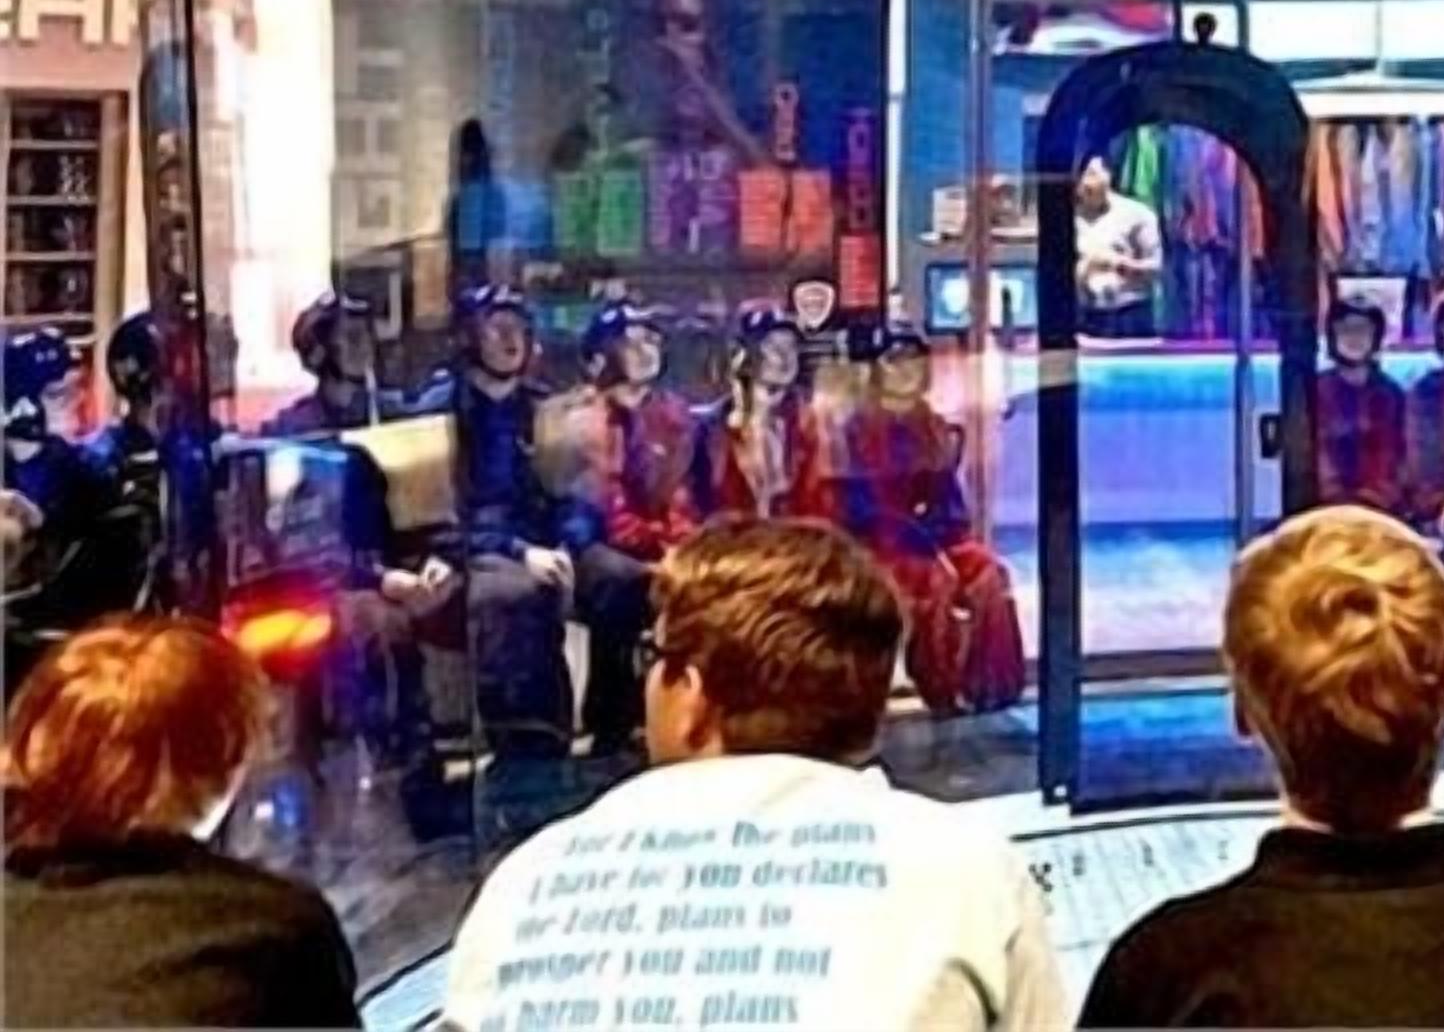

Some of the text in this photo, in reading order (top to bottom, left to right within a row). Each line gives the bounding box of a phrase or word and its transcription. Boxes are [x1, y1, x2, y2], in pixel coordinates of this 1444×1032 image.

[678, 861, 743, 894] you
[752, 858, 889, 889] declares
[655, 902, 747, 935] plans
[758, 901, 793, 928] to
[621, 945, 684, 978] you
[694, 944, 763, 975] and
[773, 945, 832, 977] not
[516, 997, 601, 1030] harm
[699, 990, 800, 1030] plans
